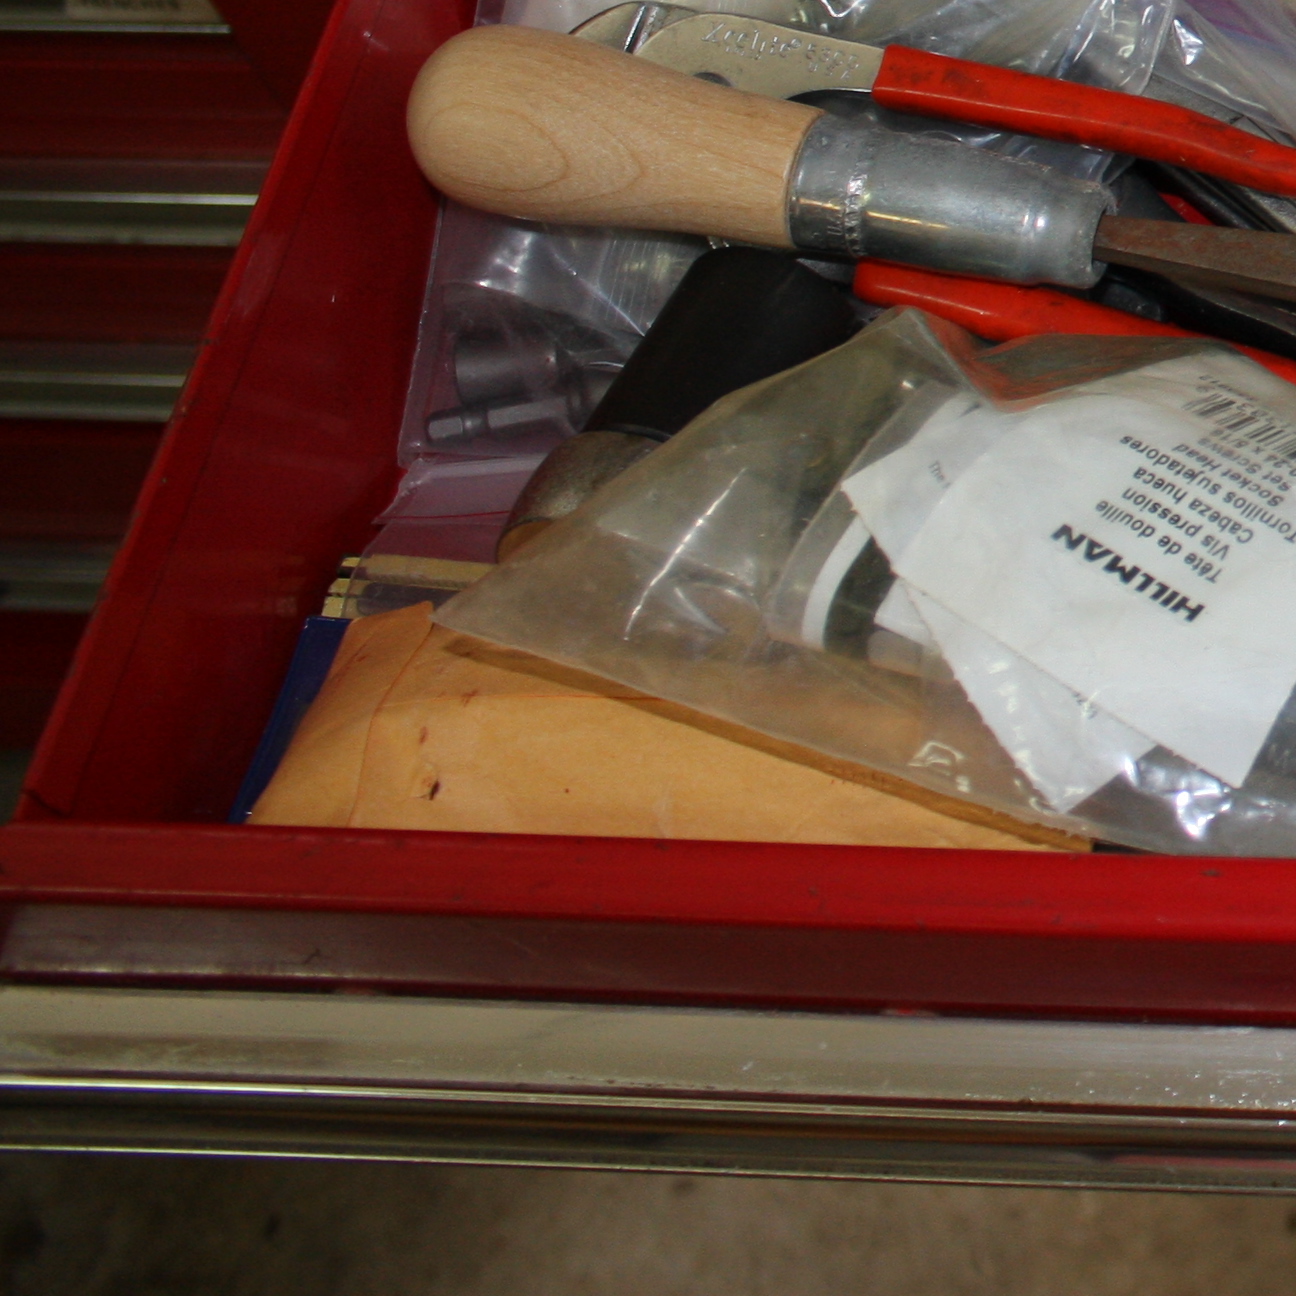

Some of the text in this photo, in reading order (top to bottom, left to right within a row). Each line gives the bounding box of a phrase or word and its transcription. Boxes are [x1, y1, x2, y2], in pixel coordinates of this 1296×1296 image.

[1118, 434, 1223, 497] sujetadores
[1170, 442, 1286, 507] Socket Head
[1094, 499, 1157, 540] douille
[1121, 486, 1231, 561] Vis pression
[1132, 466, 1255, 545] Cabeza hueca
[1050, 522, 1207, 623] HILLMAN
[1157, 533, 1183, 556] de
